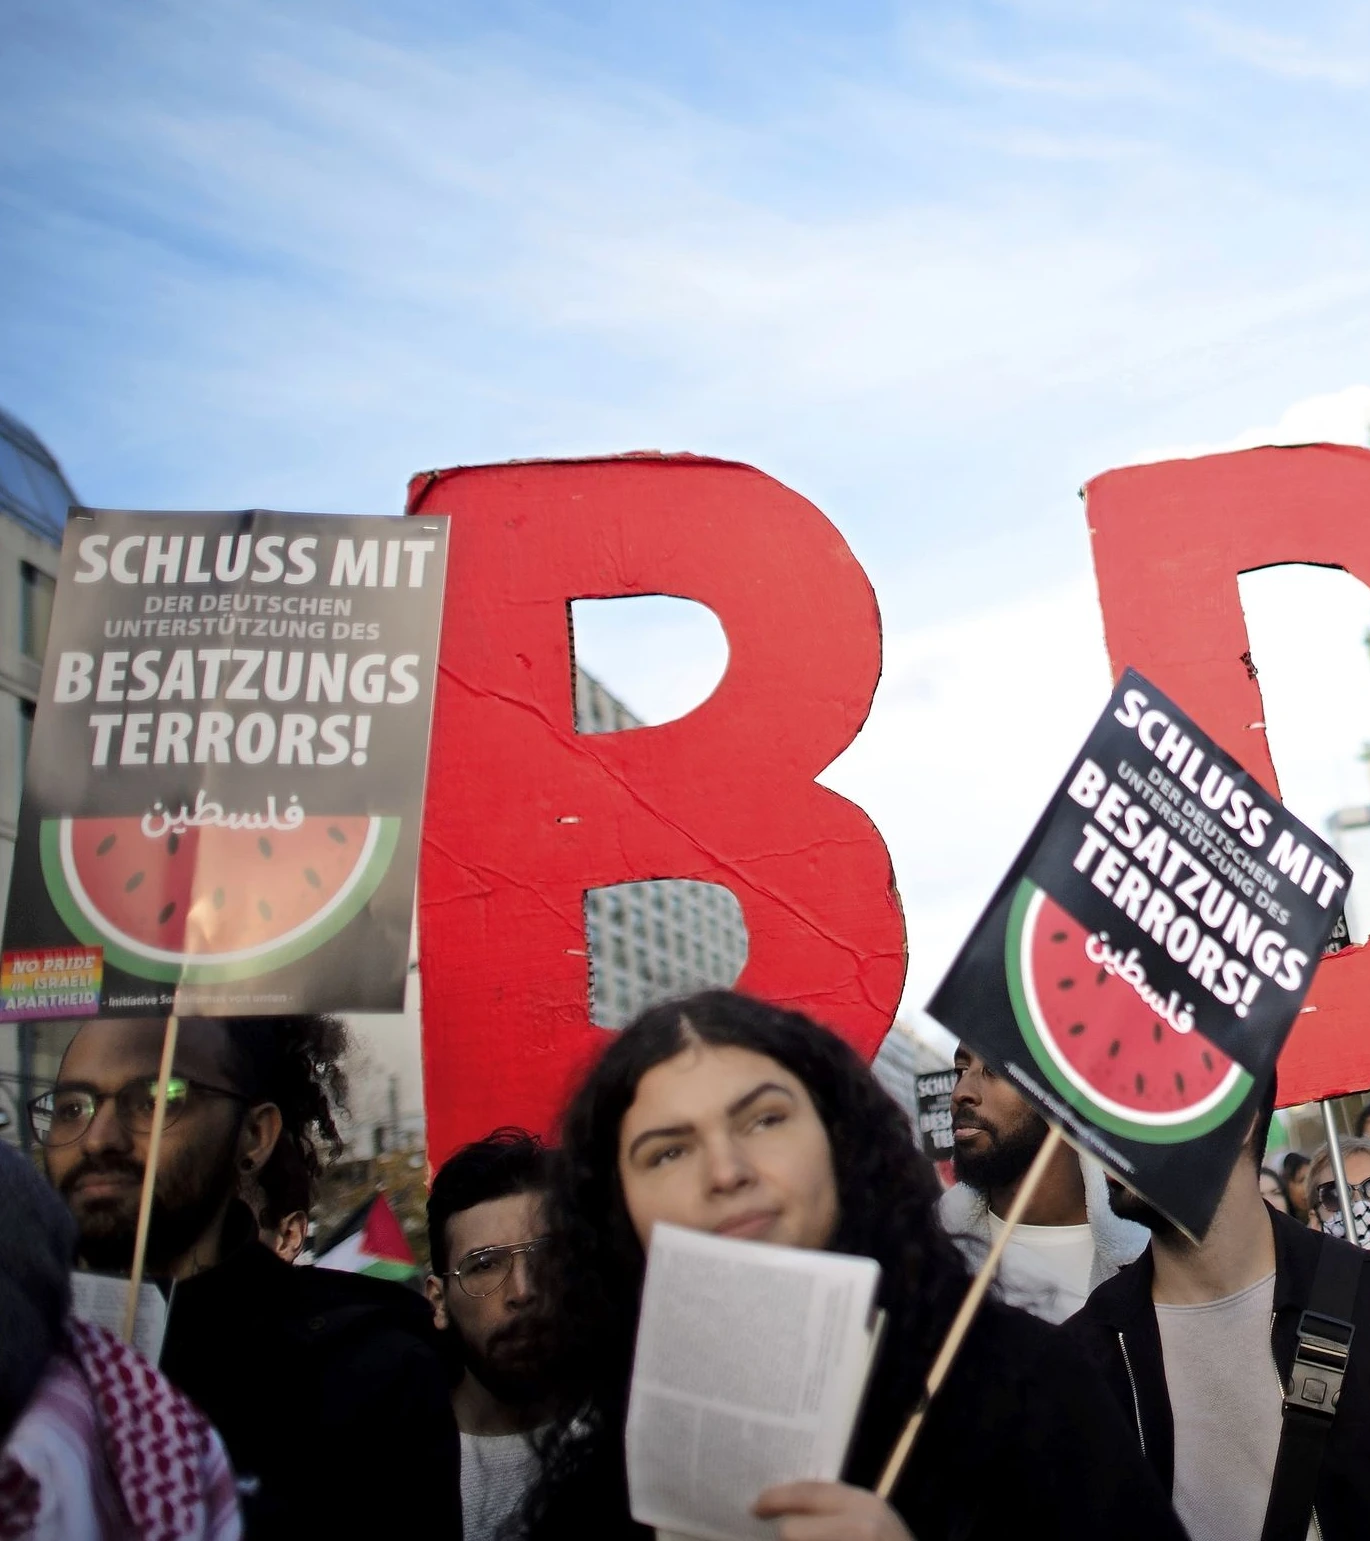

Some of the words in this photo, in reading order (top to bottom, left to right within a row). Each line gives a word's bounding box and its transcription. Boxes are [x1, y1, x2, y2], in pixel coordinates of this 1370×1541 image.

[74, 534, 318, 585] SCHLUSS
[329, 538, 435, 588] MIT
[104, 614, 325, 639] UNTERSTÜTZUNG
[331, 621, 380, 641] DES
[144, 595, 193, 614] DER
[199, 593, 352, 616] DEUTSCHEN
[54, 649, 420, 704] BESATZUNGS
[89, 711, 372, 767] TERRORS!
[141, 789, 305, 838] فلسطين
[1113, 689, 1272, 848] SCHLUSS
[1266, 829, 1345, 909] MIT
[1117, 759, 1253, 898] UNTERSTÜTZUNG
[1255, 890, 1292, 926] DES
[1147, 766, 1182, 806] DER
[1181, 798, 1278, 894] DEUTSCHEN
[1067, 758, 1309, 991] BESATZUNGS
[1073, 823, 1263, 1018] TERRORS!
[12, 959, 39, 974] NO
[43, 955, 95, 972] PRIDE
[34, 974, 92, 989] ISRAELI
[1085, 930, 1195, 1034] فلسطين
[5, 992, 96, 1010] APARTHEID
